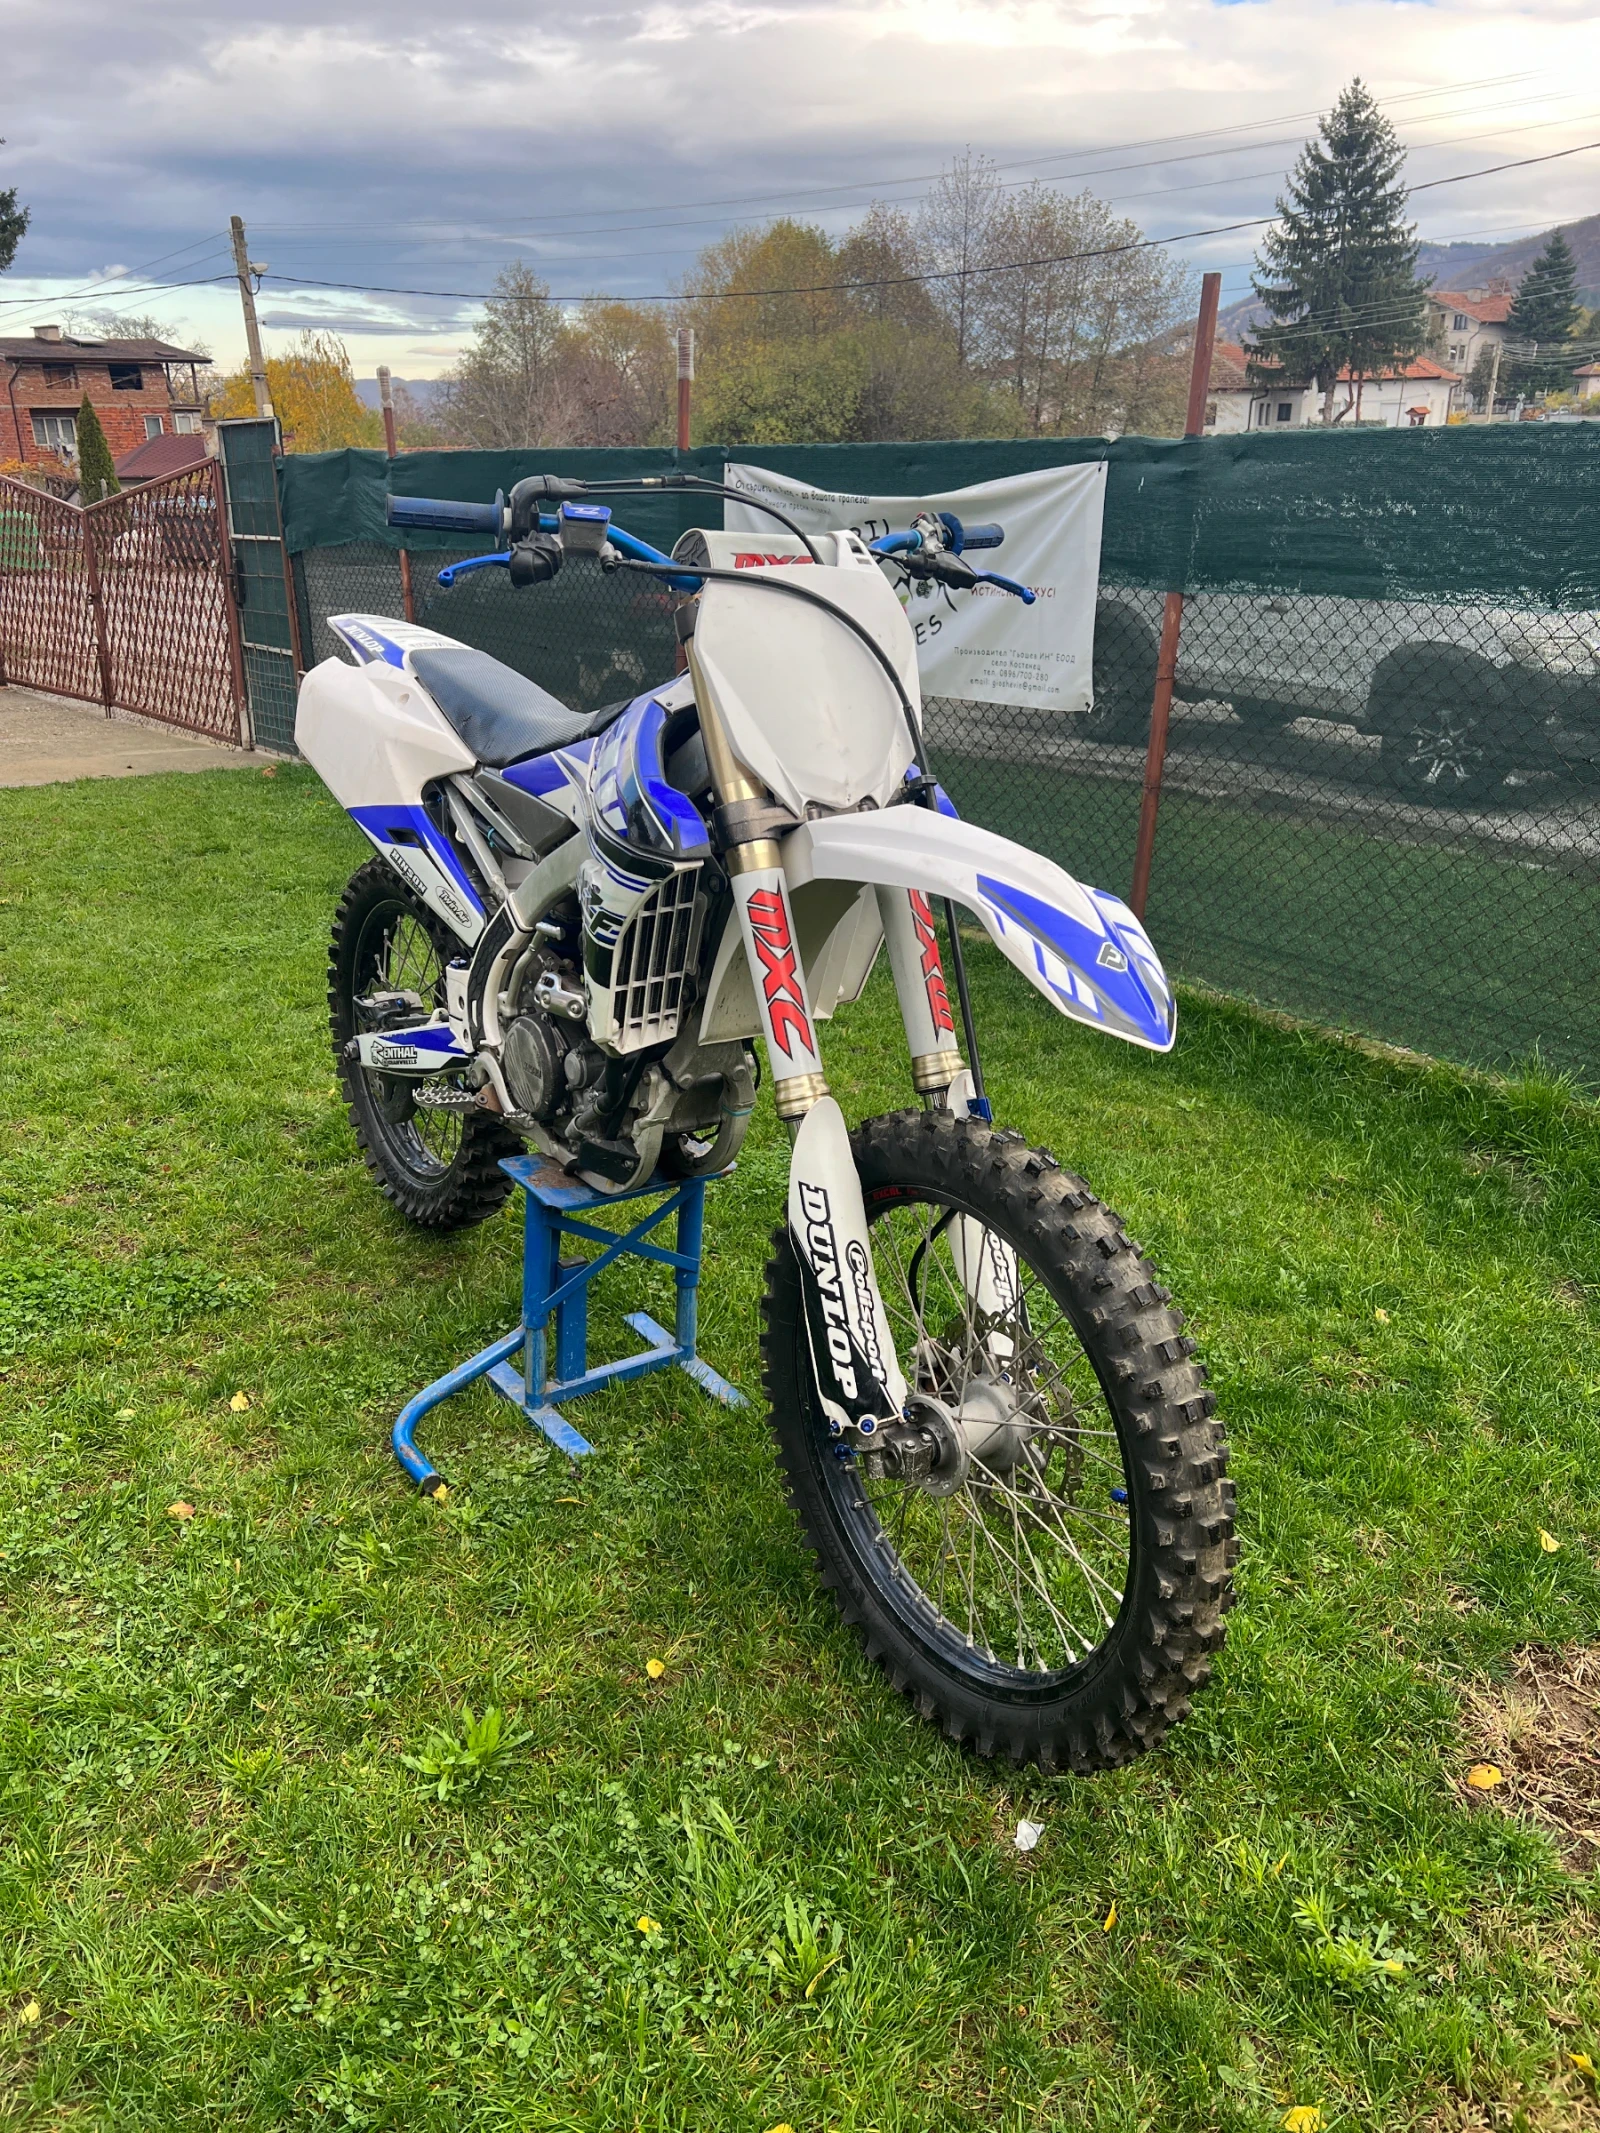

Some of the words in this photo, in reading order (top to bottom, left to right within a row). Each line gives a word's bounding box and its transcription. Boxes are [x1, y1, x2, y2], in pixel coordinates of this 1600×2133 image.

[345, 624, 386, 653] DUNLOP
[954, 646, 1008, 657] Производител
[1056, 653, 1076, 664] ЕООД
[1009, 660, 1042, 671] Костенец
[390, 848, 428, 895] HINSON
[371, 1040, 418, 1067] RENTHAL
[798, 1180, 859, 1400] DUNLOP
[845, 1239, 888, 1386] Polisport
